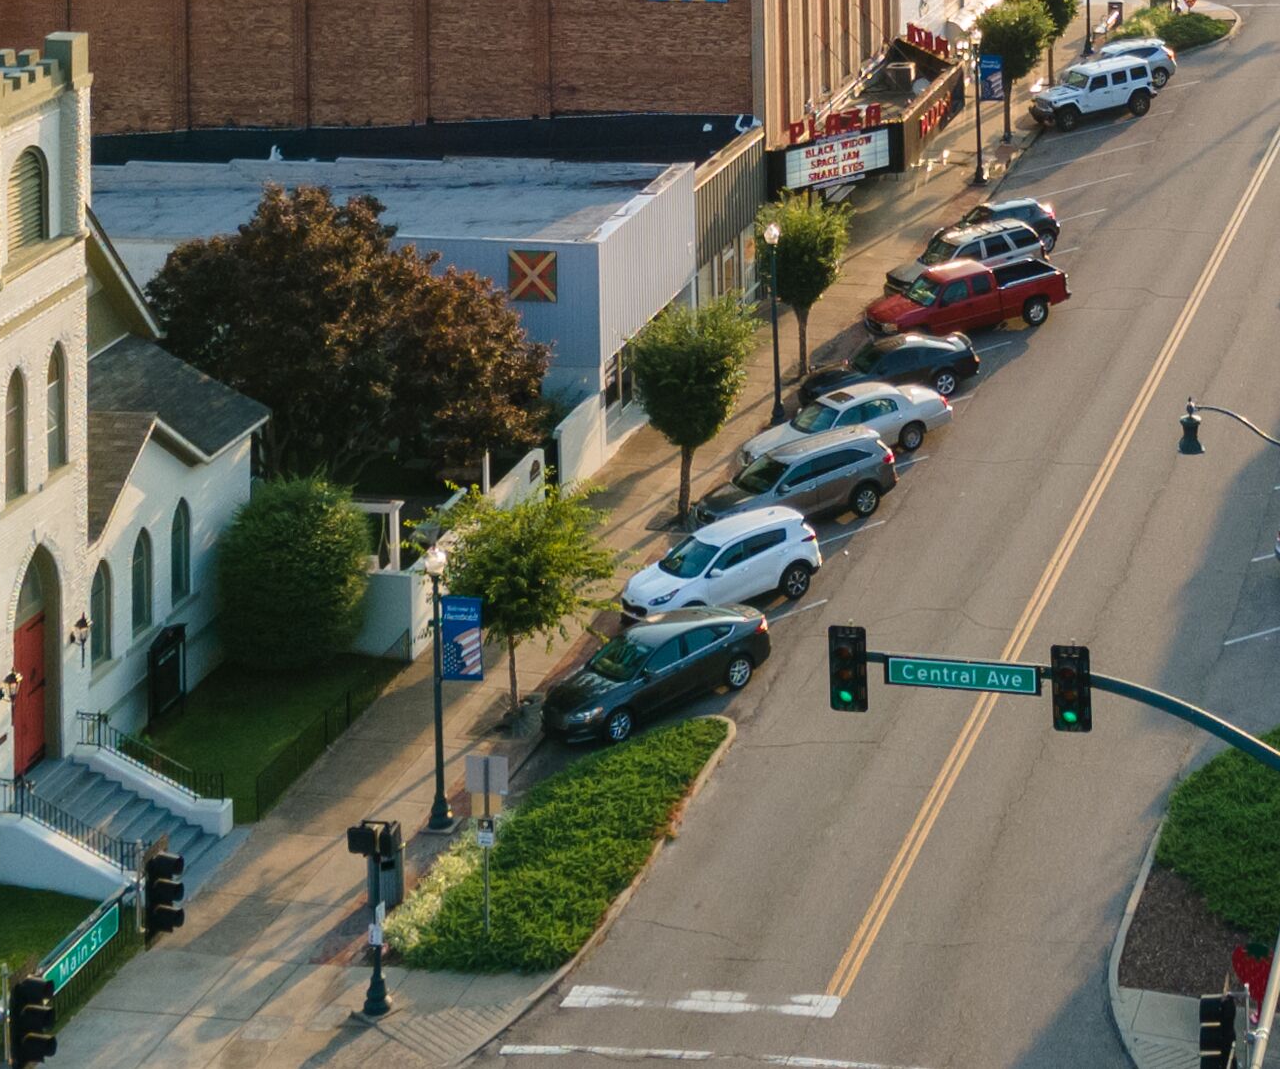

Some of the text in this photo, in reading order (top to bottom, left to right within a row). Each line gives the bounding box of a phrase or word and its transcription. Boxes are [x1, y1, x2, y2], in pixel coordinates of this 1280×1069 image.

[790, 102, 881, 143] PLAZA
[805, 135, 872, 158] BLACK WIDOW
[808, 161, 865, 182] SNAKE EYES
[811, 151, 860, 169] SPACE JAM
[902, 664, 1023, 688] Central Ave
[59, 927, 103, 981] Main St
